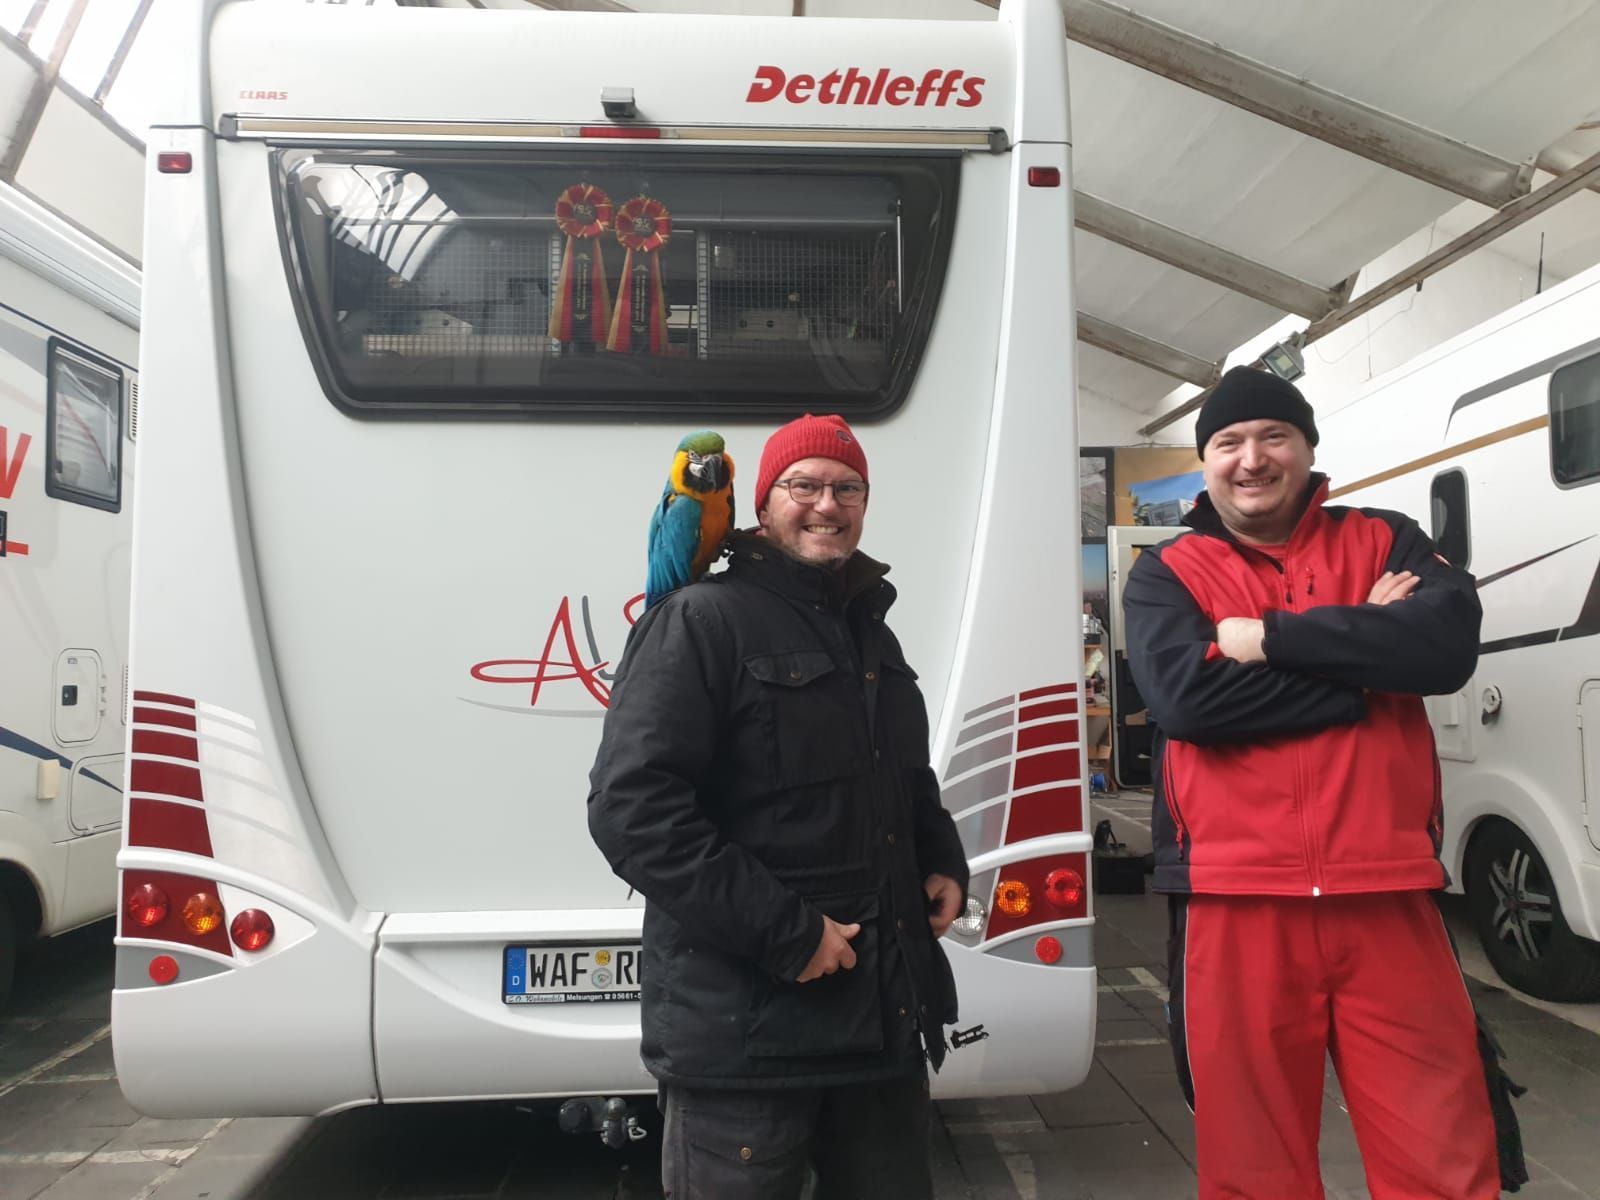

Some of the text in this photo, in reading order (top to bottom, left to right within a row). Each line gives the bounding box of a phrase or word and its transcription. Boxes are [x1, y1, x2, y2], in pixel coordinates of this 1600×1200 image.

[239, 90, 288, 100] CLAAS
[745, 65, 986, 108] Dethleffs
[512, 975, 520, 986] D
[529, 951, 641, 988] WAF R
